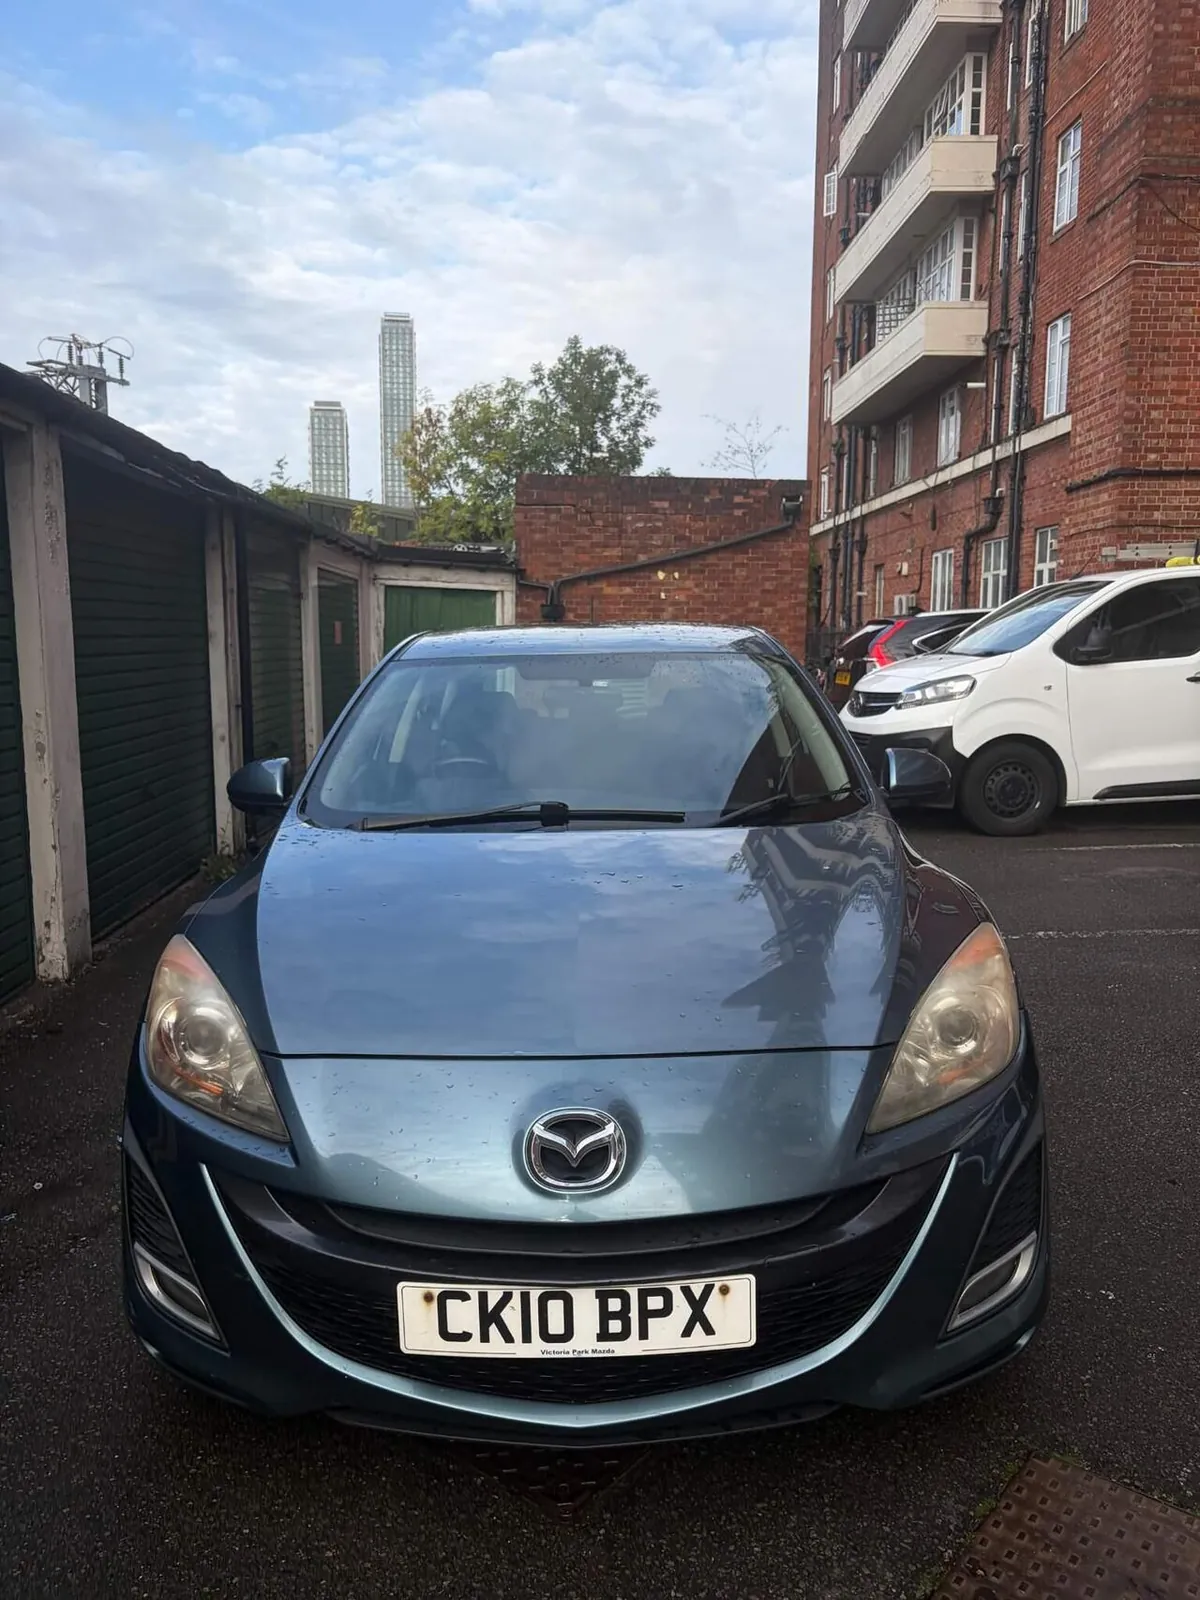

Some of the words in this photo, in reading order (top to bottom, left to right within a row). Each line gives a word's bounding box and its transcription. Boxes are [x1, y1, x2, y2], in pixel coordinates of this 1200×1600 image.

[437, 1290, 574, 1344] CK10
[595, 1283, 716, 1343] BPX
[572, 1348, 589, 1356] Park
